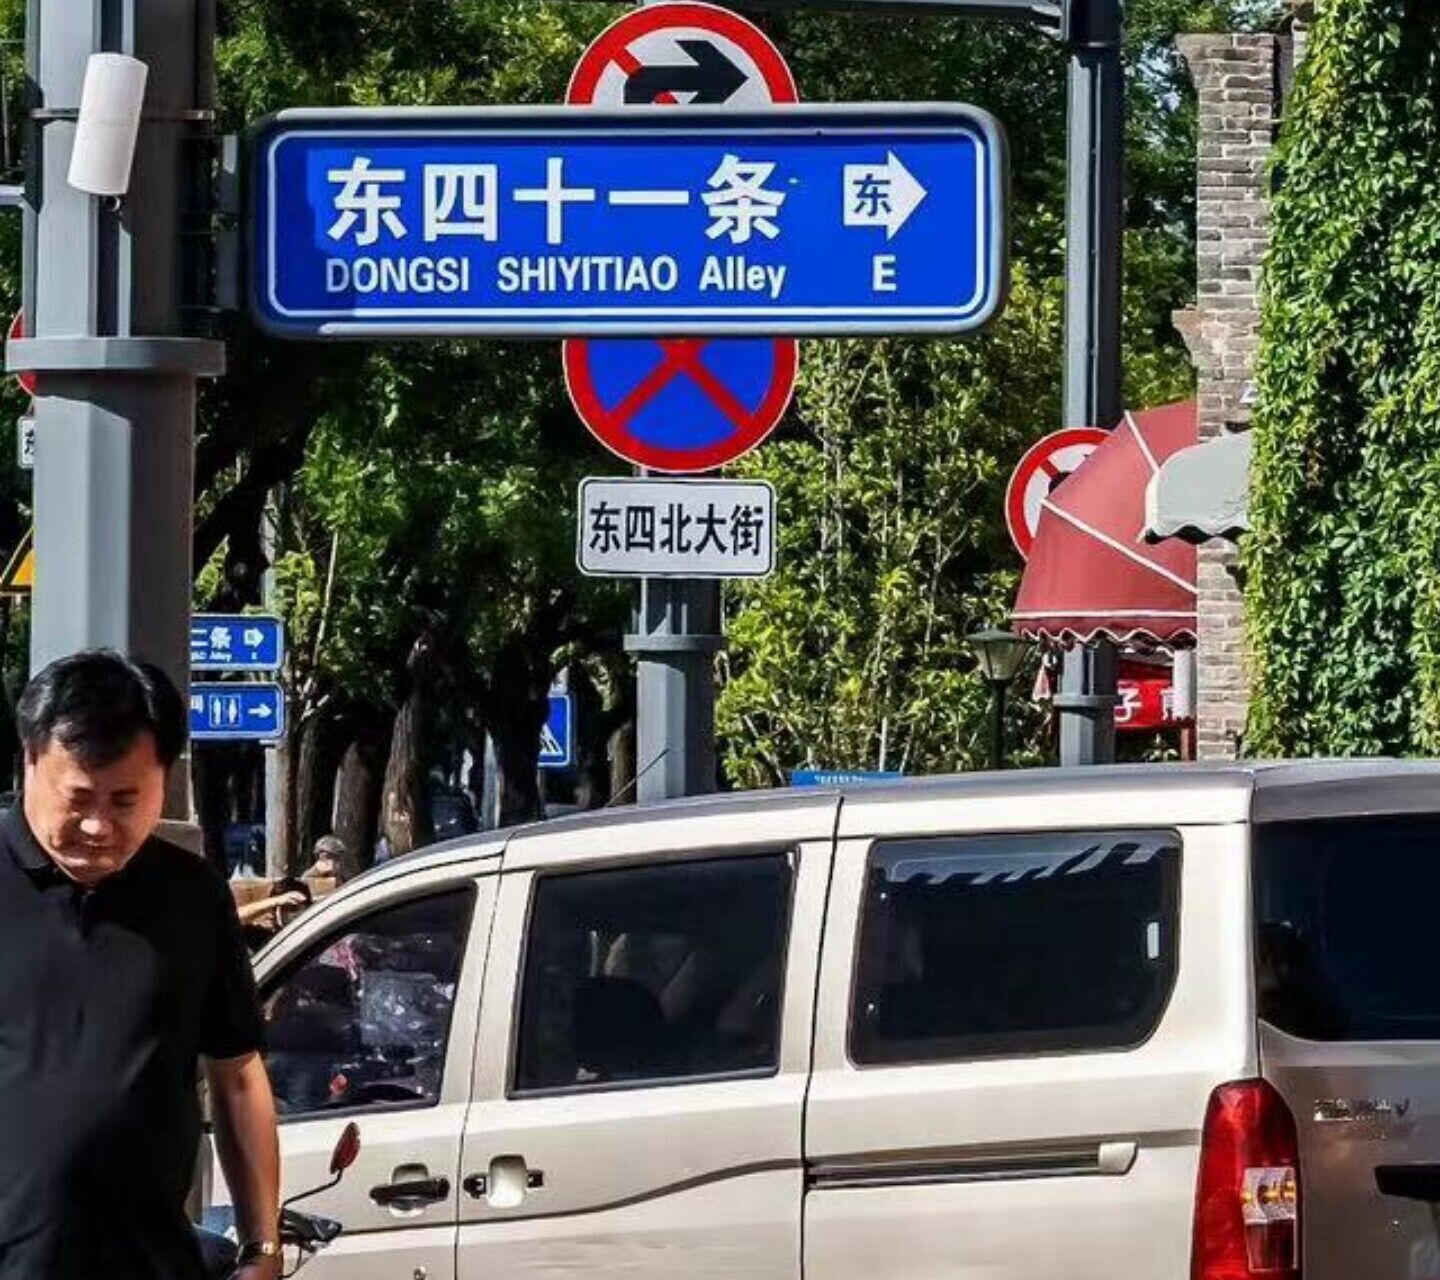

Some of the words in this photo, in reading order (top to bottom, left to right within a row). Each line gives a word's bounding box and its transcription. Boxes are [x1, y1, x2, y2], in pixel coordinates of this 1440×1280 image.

[327, 153, 787, 245] 东四十一条
[852, 173, 893, 218] 东
[326, 256, 469, 293] DONGSI
[497, 256, 678, 293] SHIYITIAO
[698, 255, 787, 299] Alley
[872, 254, 897, 292] E
[588, 501, 764, 557] 东四北大街
